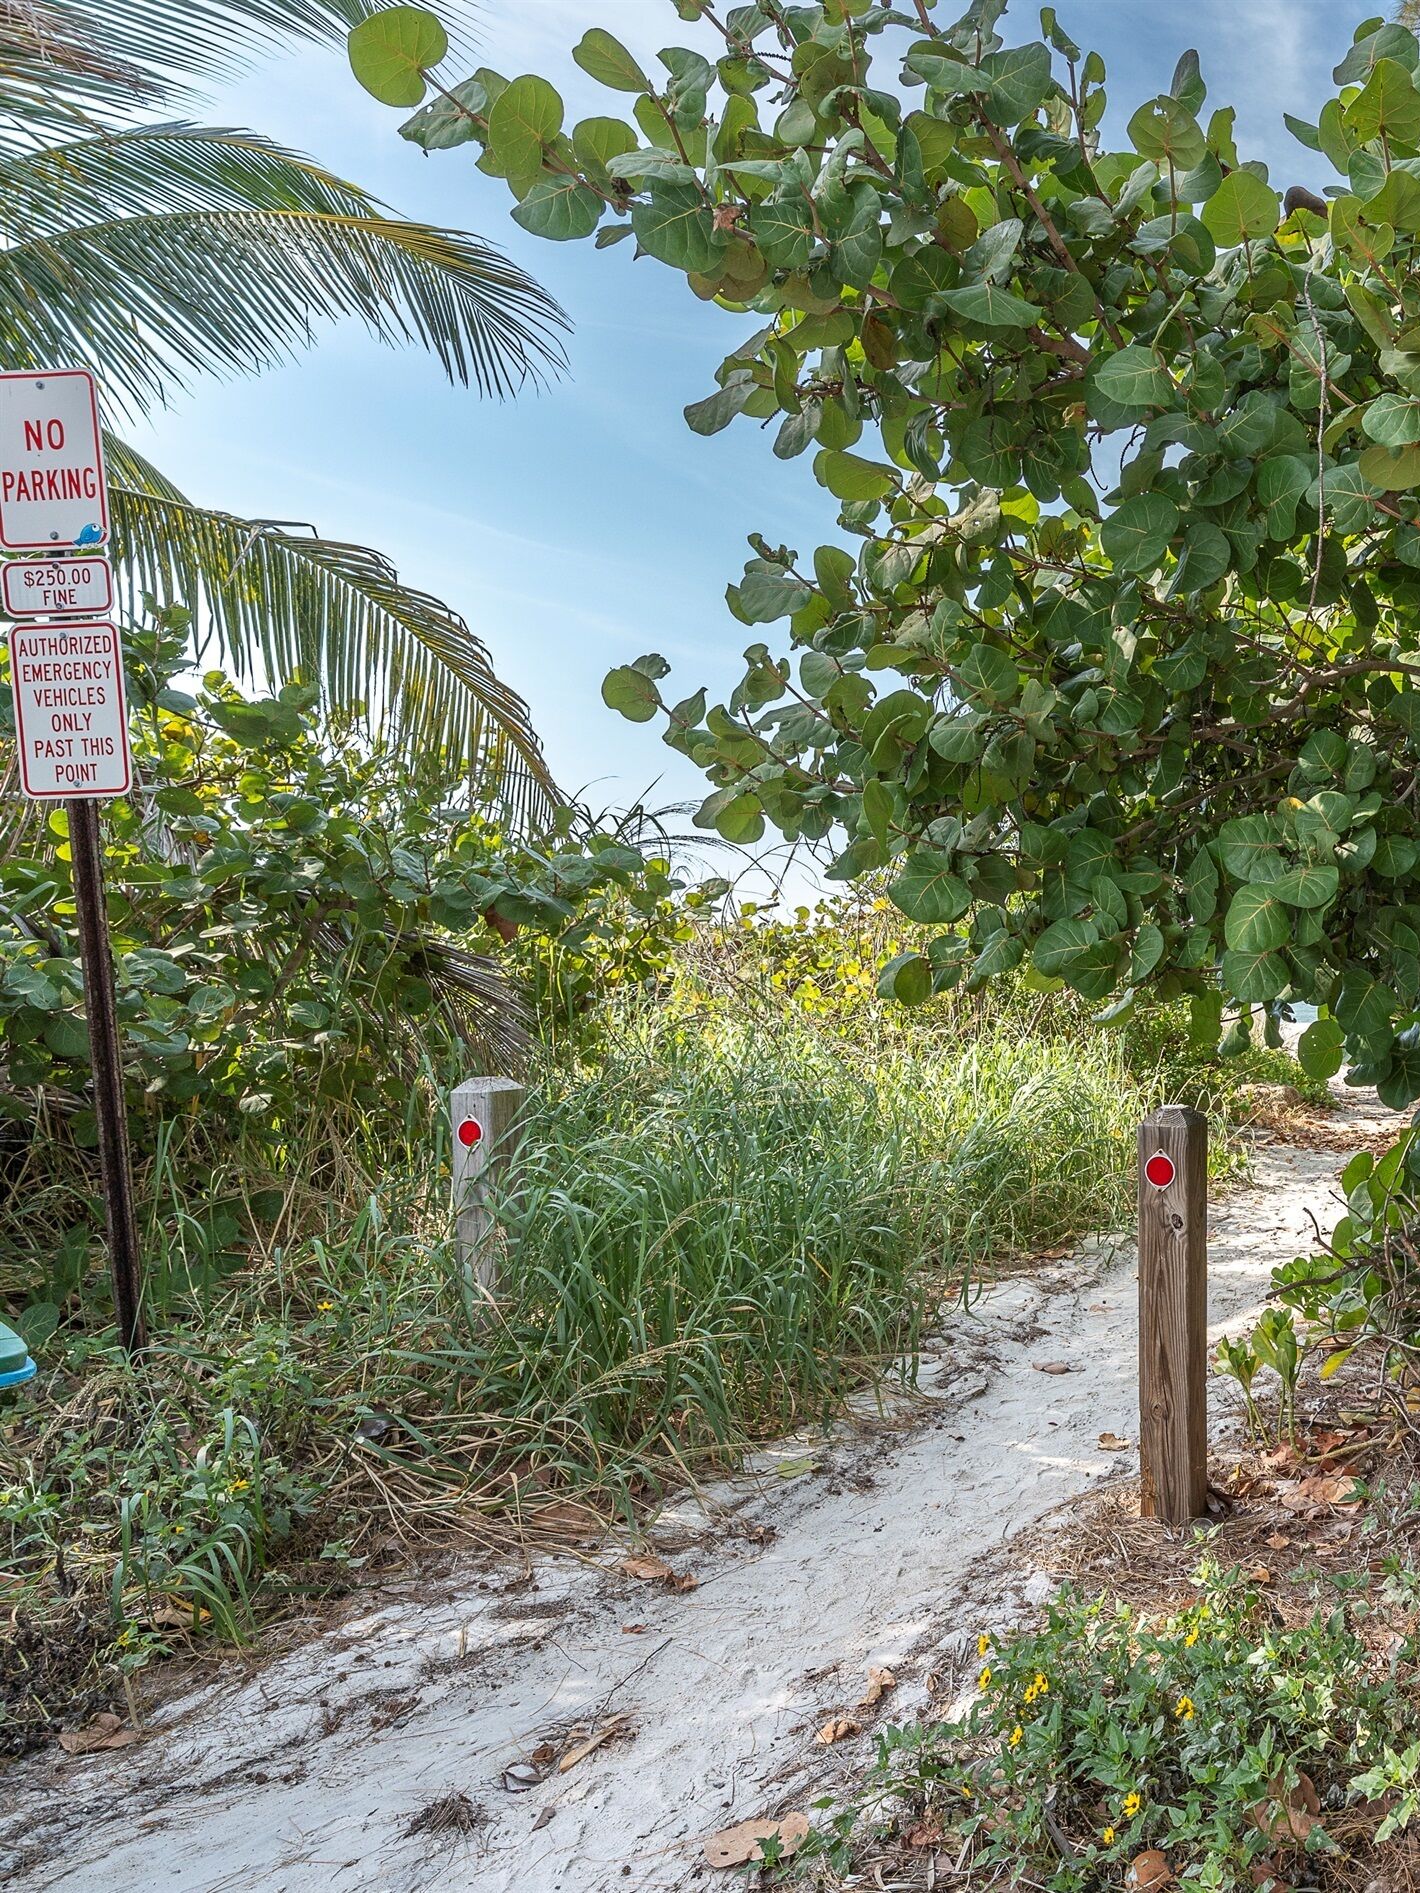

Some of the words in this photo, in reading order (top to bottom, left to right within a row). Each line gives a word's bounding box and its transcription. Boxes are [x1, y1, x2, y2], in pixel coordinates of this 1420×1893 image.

[24, 419, 65, 451] NO
[2, 467, 96, 502] PARKING
[24, 568, 91, 588] $250.00
[43, 589, 77, 606] FINE
[19, 635, 112, 657] AUTHORIZED
[22, 661, 112, 682] EMERGENCY
[33, 687, 106, 707] VEHICLES
[52, 713, 92, 732] ONLY
[34, 739, 73, 758] PAST
[81, 737, 114, 757] THIS
[56, 764, 97, 783] POINT
